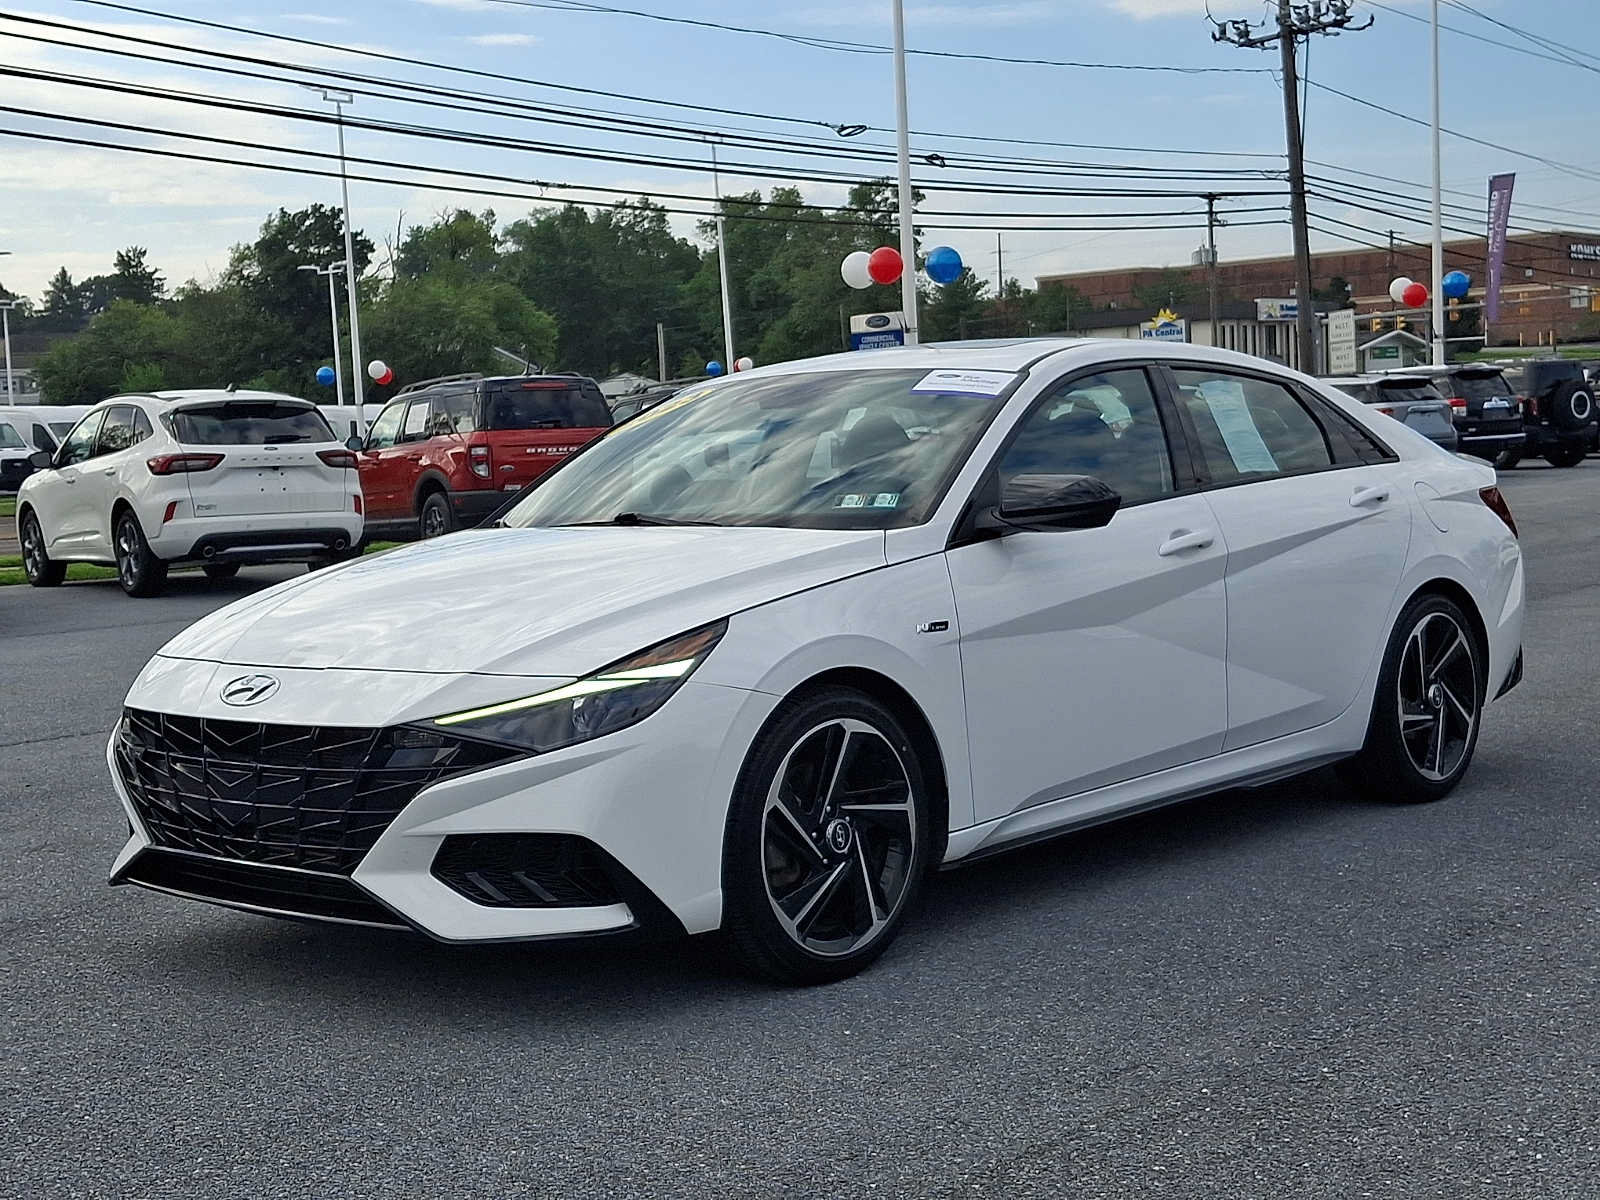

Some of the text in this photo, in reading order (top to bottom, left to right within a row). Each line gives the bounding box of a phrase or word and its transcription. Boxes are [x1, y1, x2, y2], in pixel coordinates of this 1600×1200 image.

[1143, 327, 1183, 338] PA Central
[526, 446, 578, 454] BRONC
